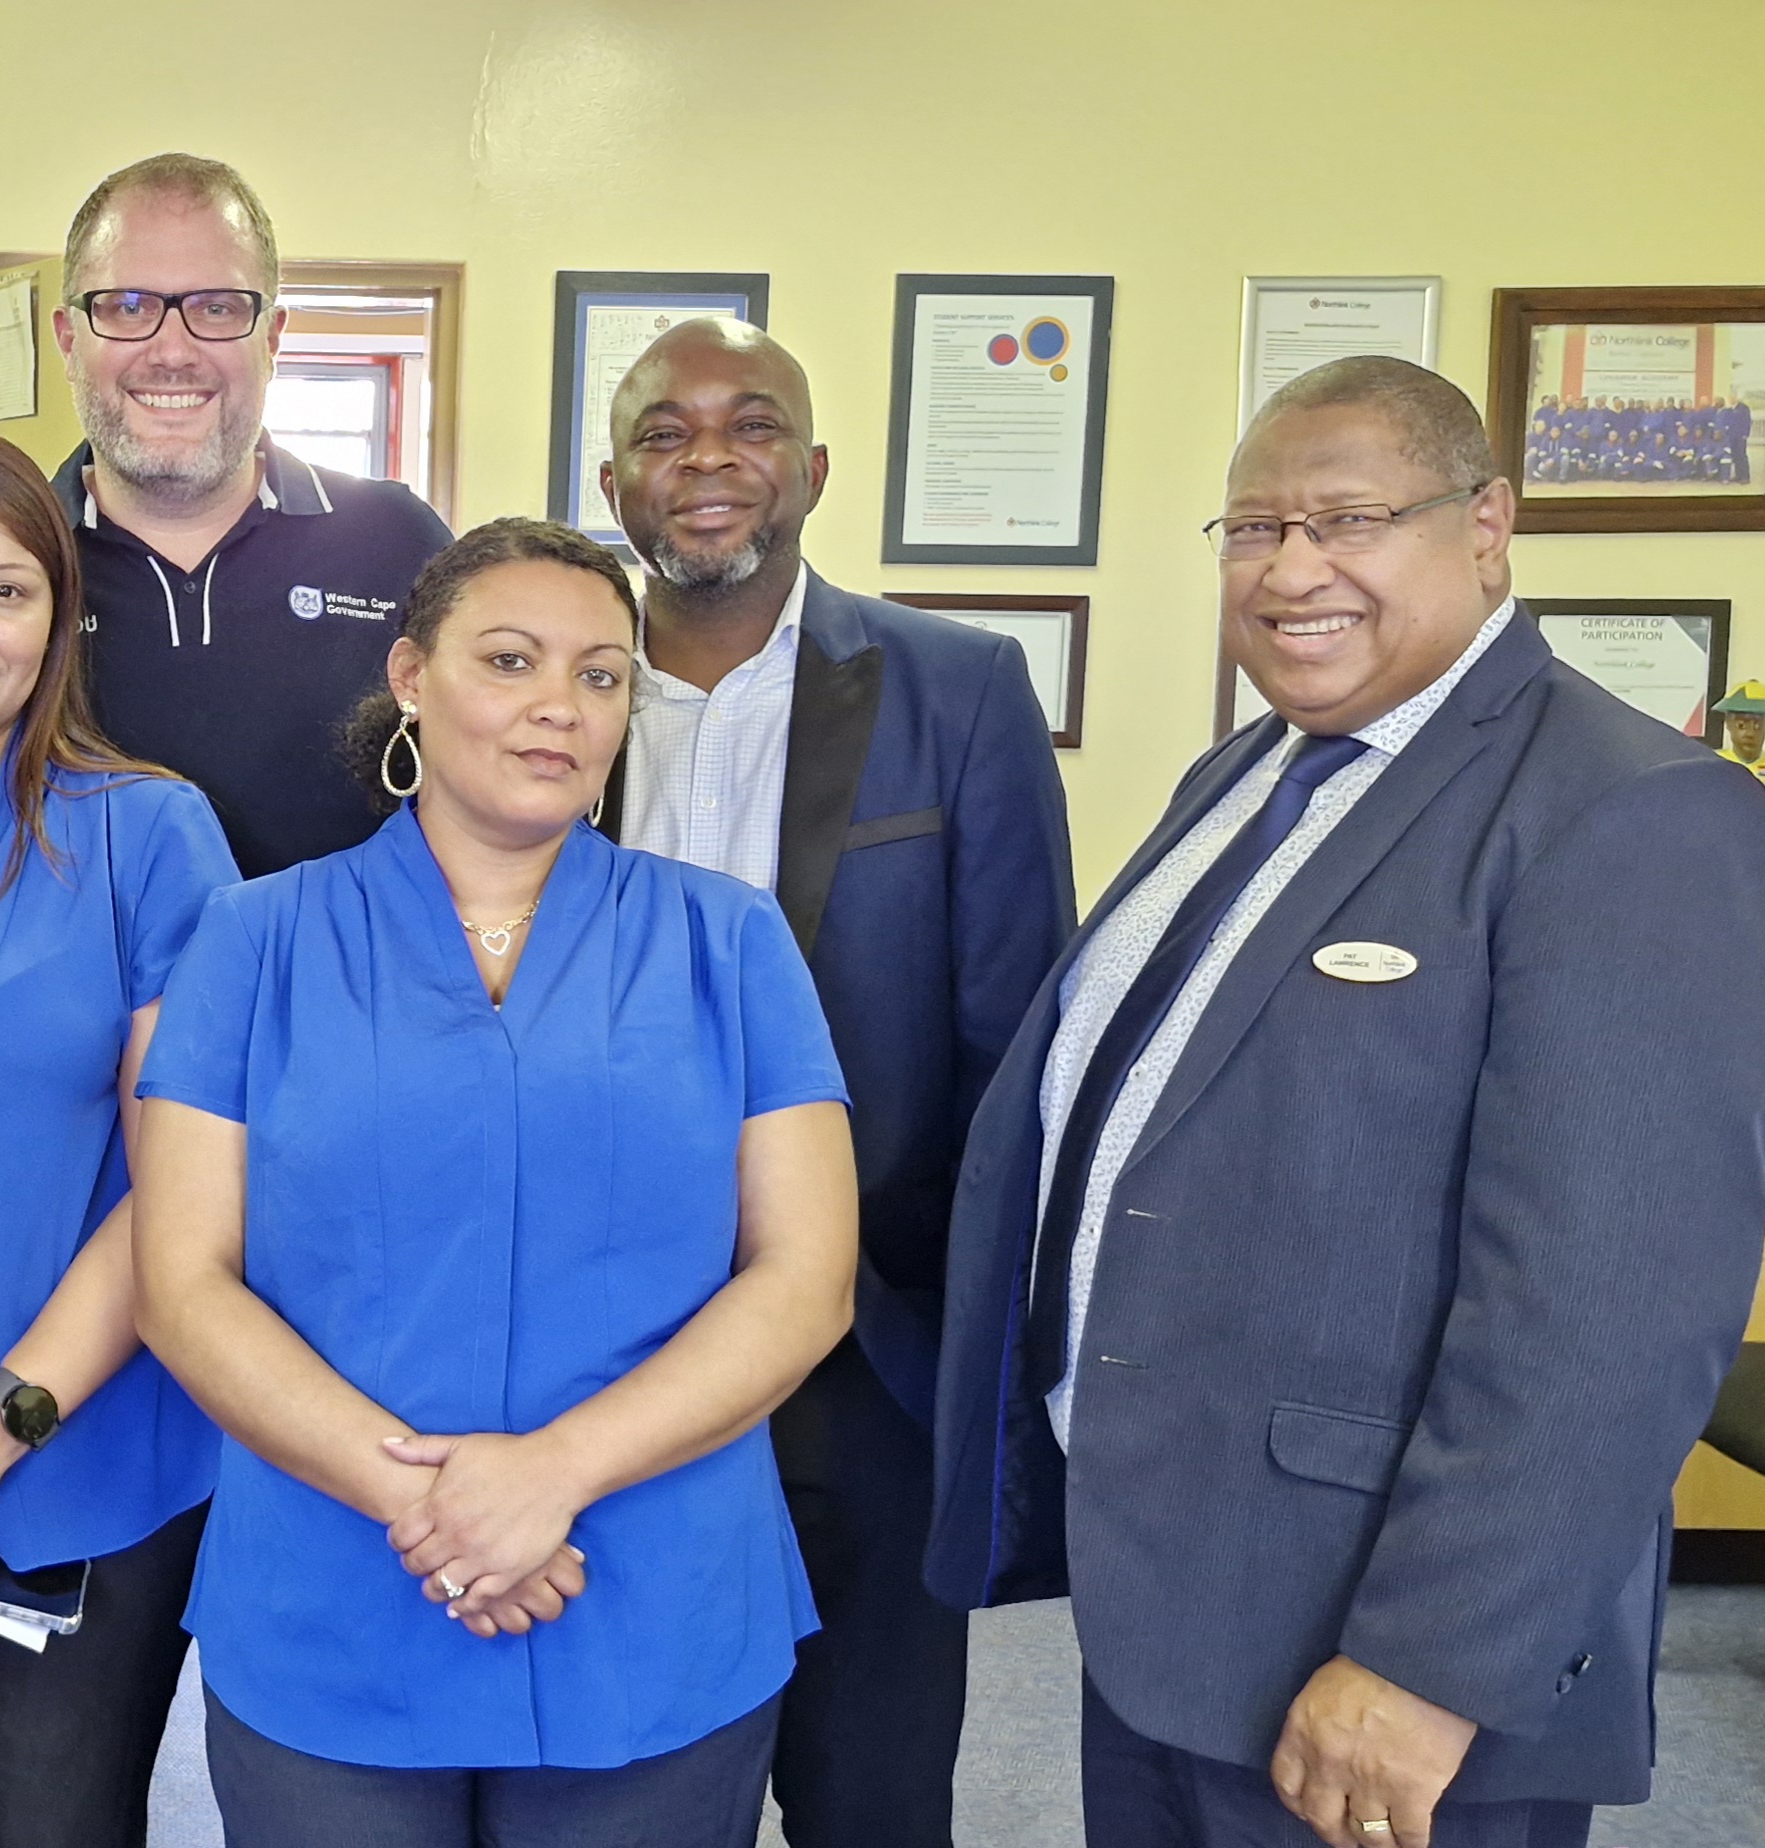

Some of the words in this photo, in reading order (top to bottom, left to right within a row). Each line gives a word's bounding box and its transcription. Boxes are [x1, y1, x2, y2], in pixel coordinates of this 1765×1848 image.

[1655, 335, 1691, 350] College
[325, 593, 367, 607] Western
[370, 598, 396, 611] Cape
[326, 605, 385, 620] Government
[1580, 617, 1647, 629] CERTIFICATE
[1650, 618, 1667, 629] OF
[1581, 631, 1663, 641] PARTICIPATION
[1329, 960, 1370, 969] LAWRENCE
